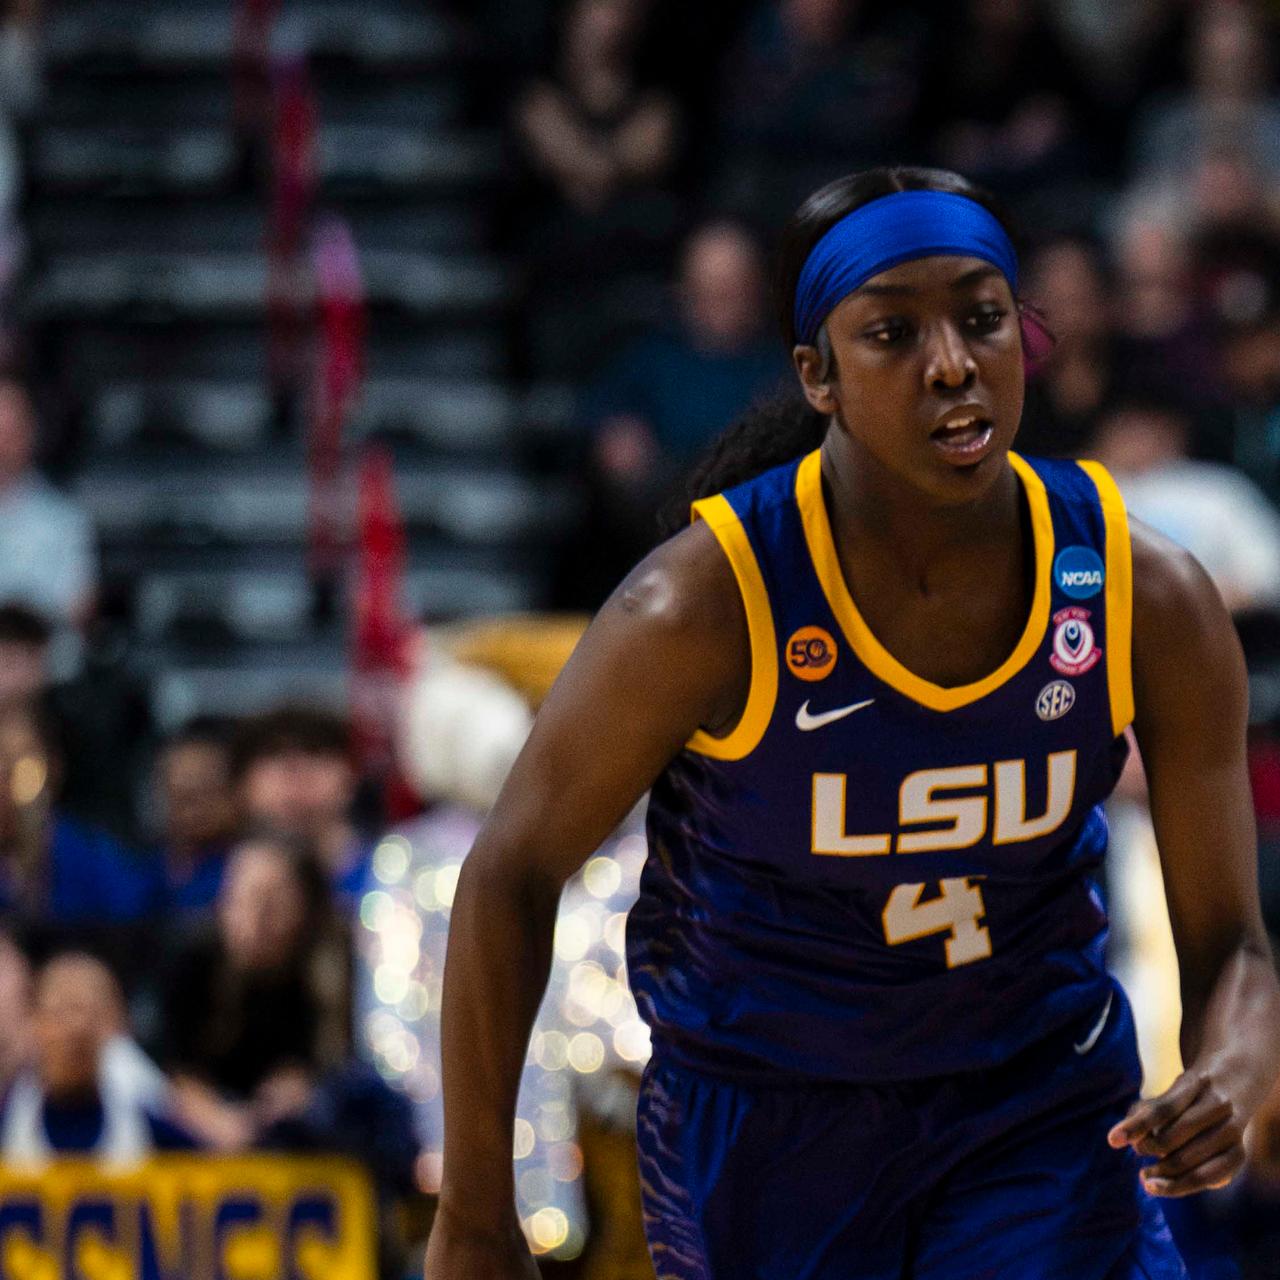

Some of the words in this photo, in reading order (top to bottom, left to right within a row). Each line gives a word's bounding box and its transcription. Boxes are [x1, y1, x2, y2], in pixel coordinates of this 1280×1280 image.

[1062, 570, 1102, 587] NCAA
[1040, 685, 1072, 718] SEC
[810, 749, 1078, 856] LSU
[881, 874, 993, 970] 4
